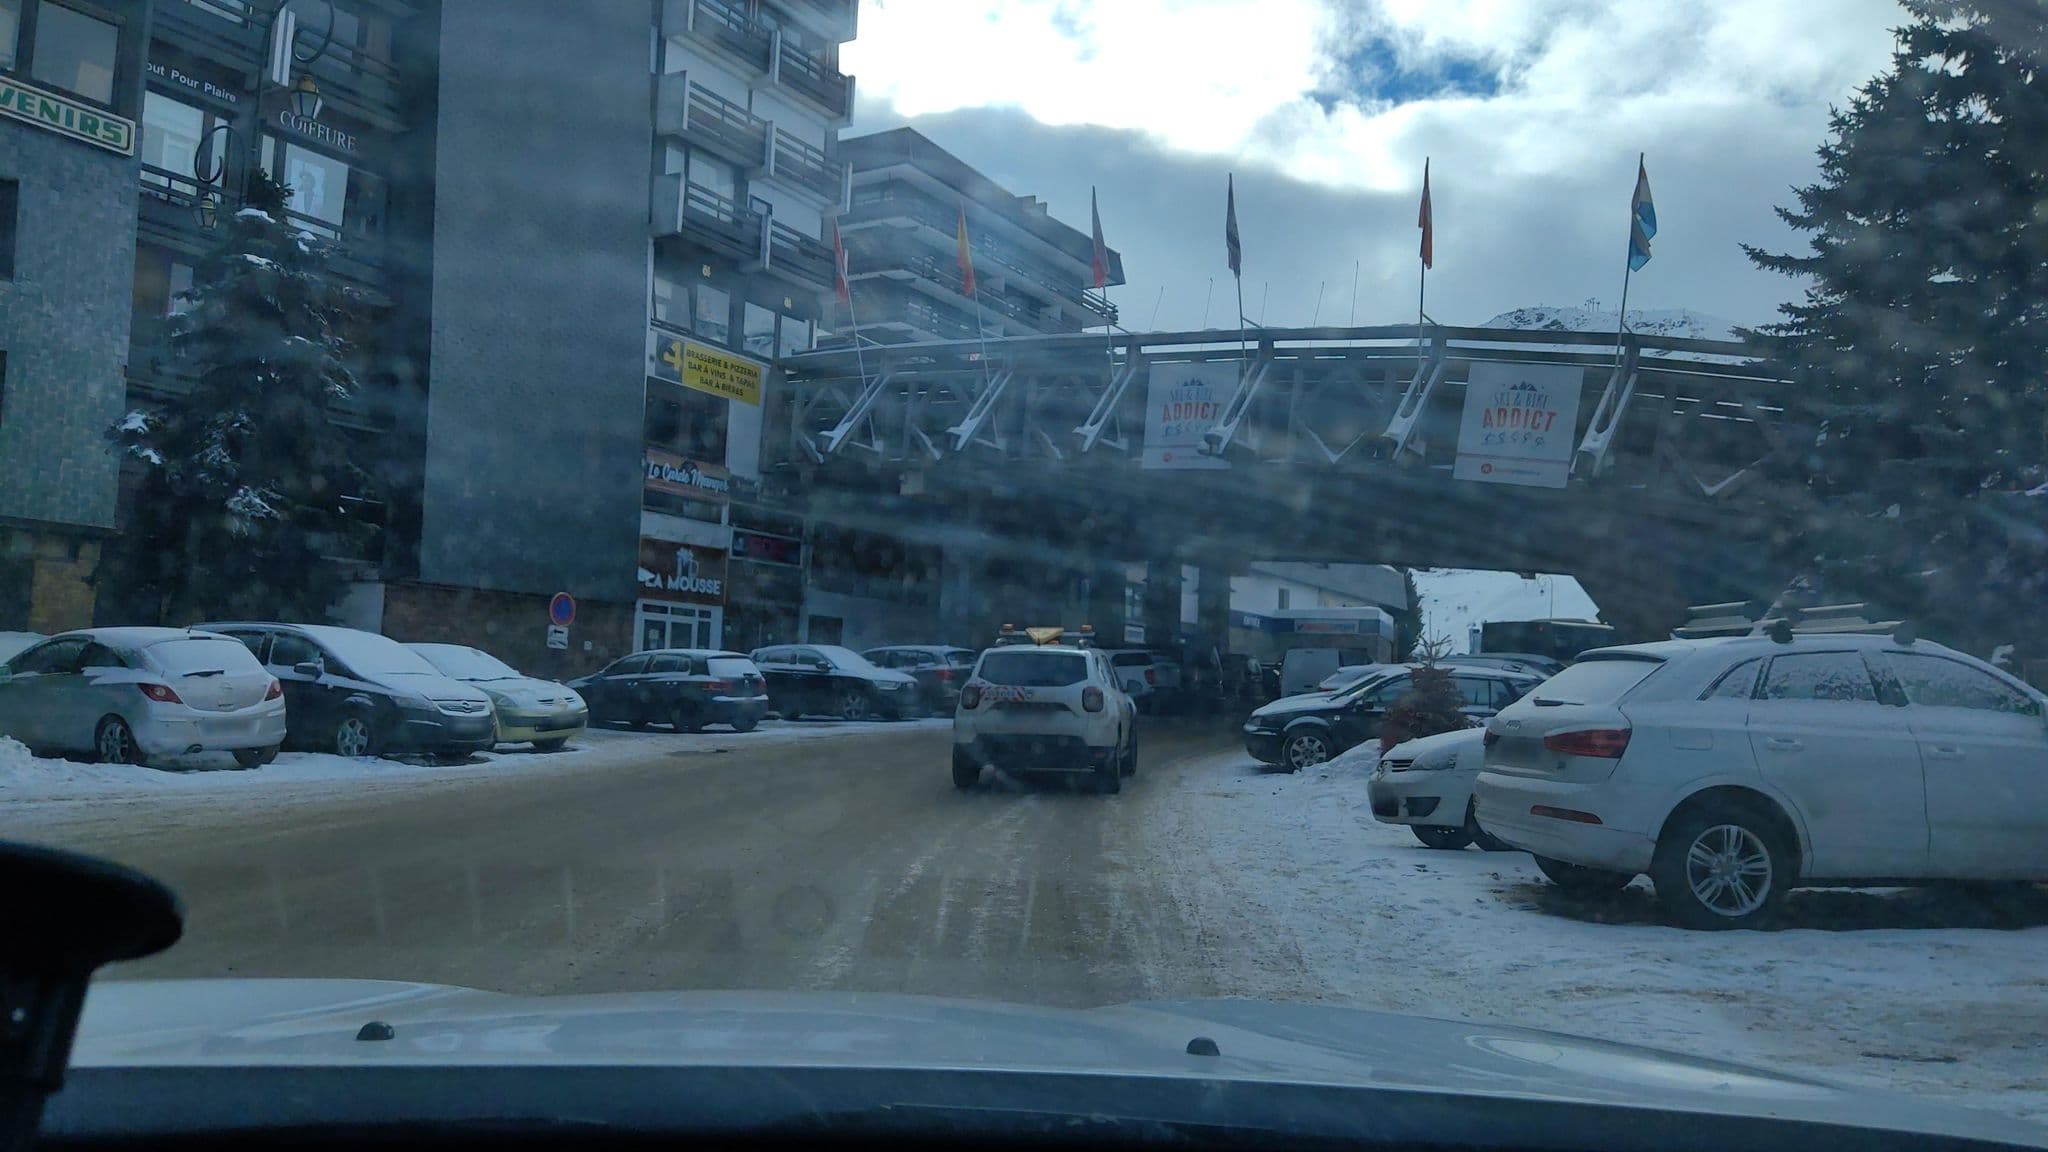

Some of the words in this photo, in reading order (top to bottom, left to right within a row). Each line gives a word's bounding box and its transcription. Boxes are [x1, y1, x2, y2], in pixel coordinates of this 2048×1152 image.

[170, 68, 200, 89] Pour
[204, 81, 237, 103] Plaire
[280, 110, 357, 152] COIFFURE
[686, 348, 722, 368] BRASSERIE
[730, 362, 759, 378] PIZZERIA
[687, 360, 702, 373] BAR
[710, 367, 727, 380] VINS
[700, 375, 714, 387] BAR
[1162, 401, 1222, 423] ADDICT
[1482, 407, 1558, 433] ADDICT
[667, 574, 722, 596] MOUSSE
